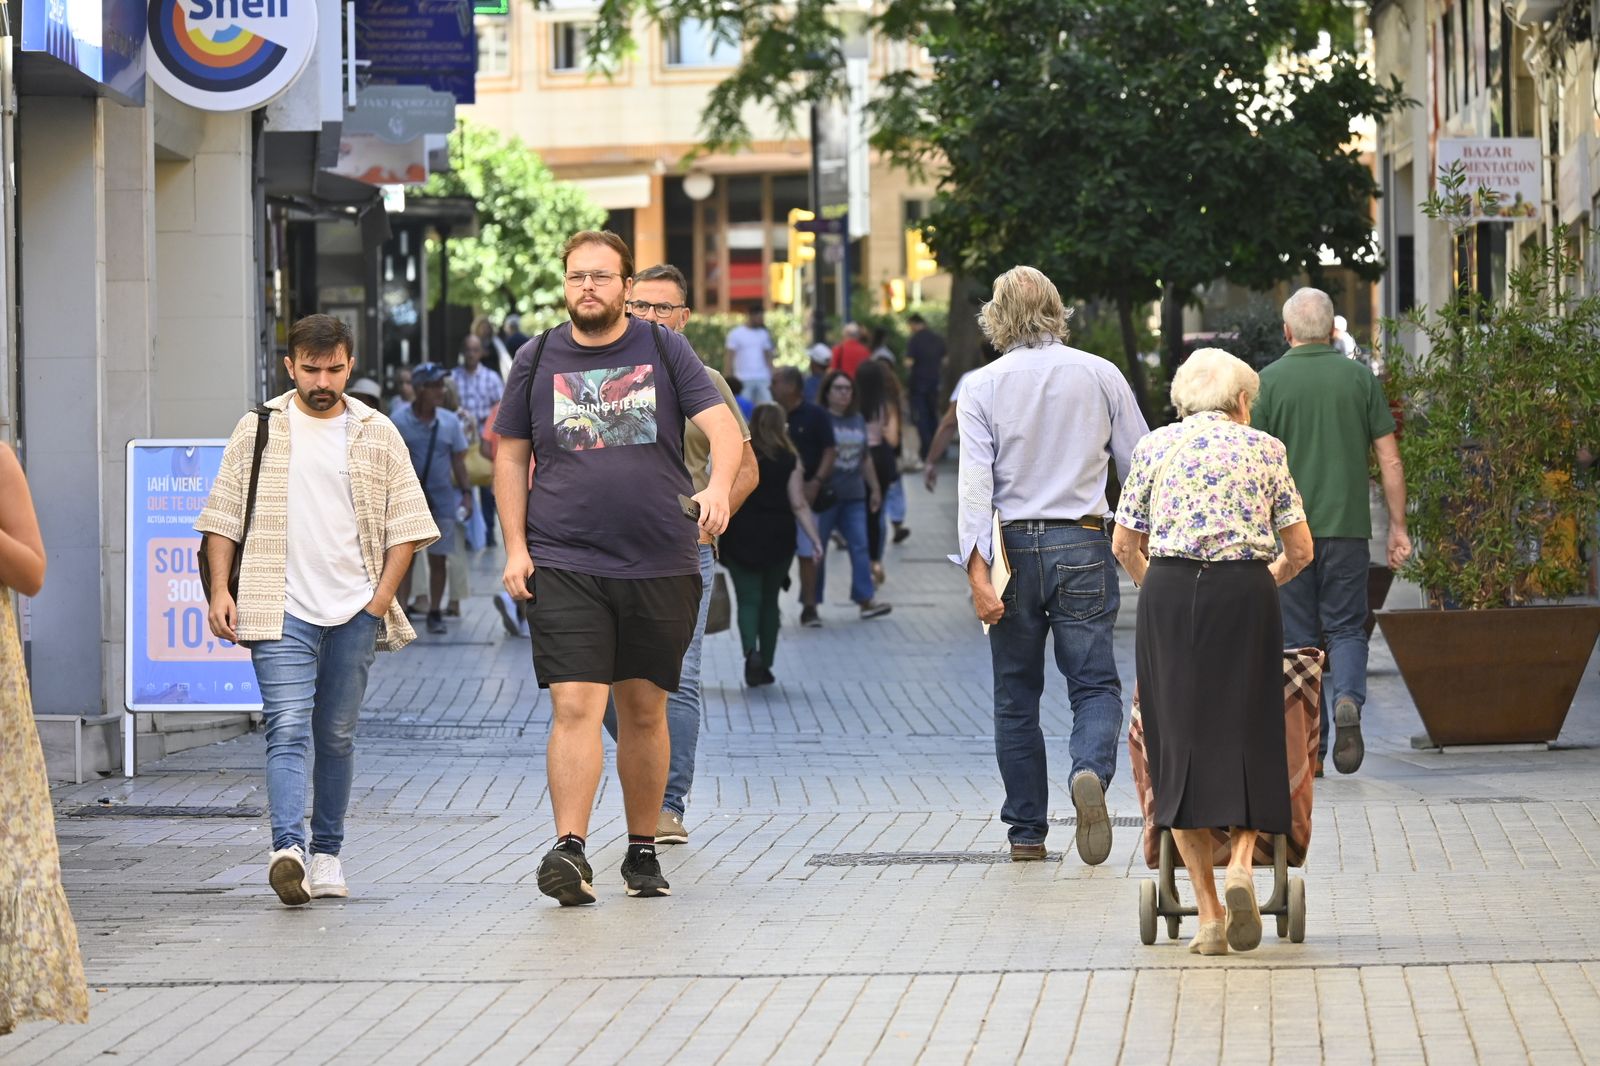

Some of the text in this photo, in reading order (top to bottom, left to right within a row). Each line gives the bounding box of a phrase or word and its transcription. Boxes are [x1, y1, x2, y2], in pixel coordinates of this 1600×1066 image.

[1463, 146, 1512, 158] BAZAR
[1444, 160, 1536, 173] AIMENTACIÓN
[1468, 176, 1521, 187] FRUTAS
[560, 399, 649, 415] SPRINGFIELD
[171, 476, 203, 492] VIENE
[147, 495, 209, 511] QUE TE GUS
[155, 547, 199, 574] SOL
[163, 607, 237, 653] 10,
